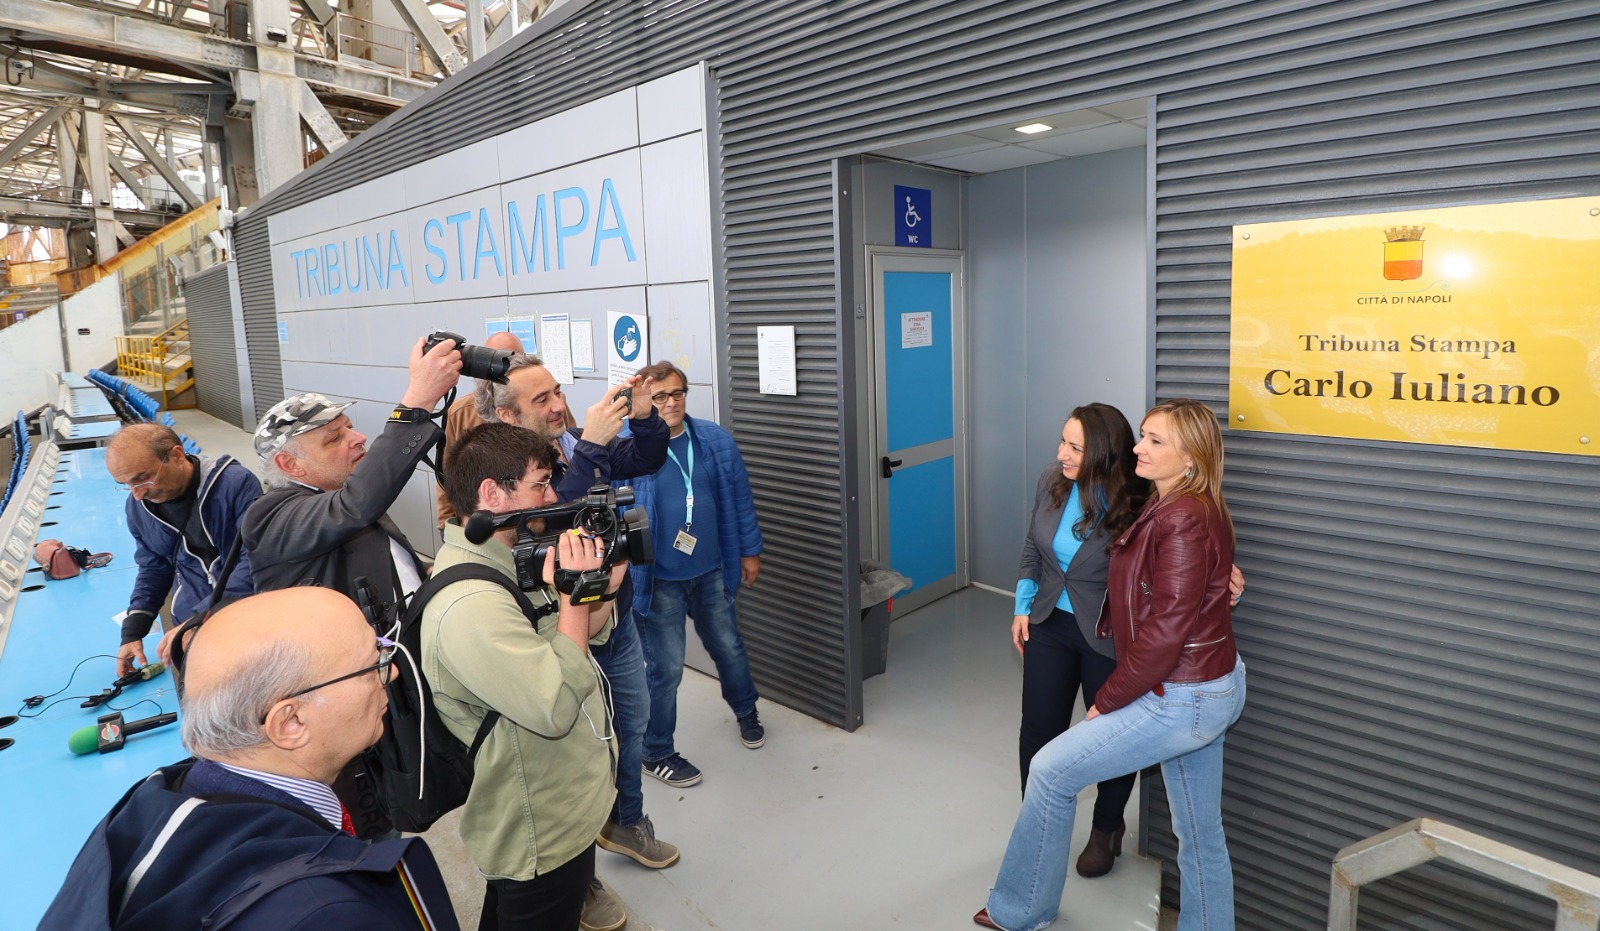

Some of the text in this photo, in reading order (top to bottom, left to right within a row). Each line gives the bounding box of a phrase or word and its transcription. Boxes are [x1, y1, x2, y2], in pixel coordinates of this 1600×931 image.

[290, 177, 637, 299] TRIBUNA STAMPA
[907, 234, 919, 244] WC
[1356, 294, 1452, 305] CITTÀ DI NAPOLI
[1298, 334, 1518, 360] Tribuna Stampa
[1263, 368, 1561, 408] Carlo Iuliano
